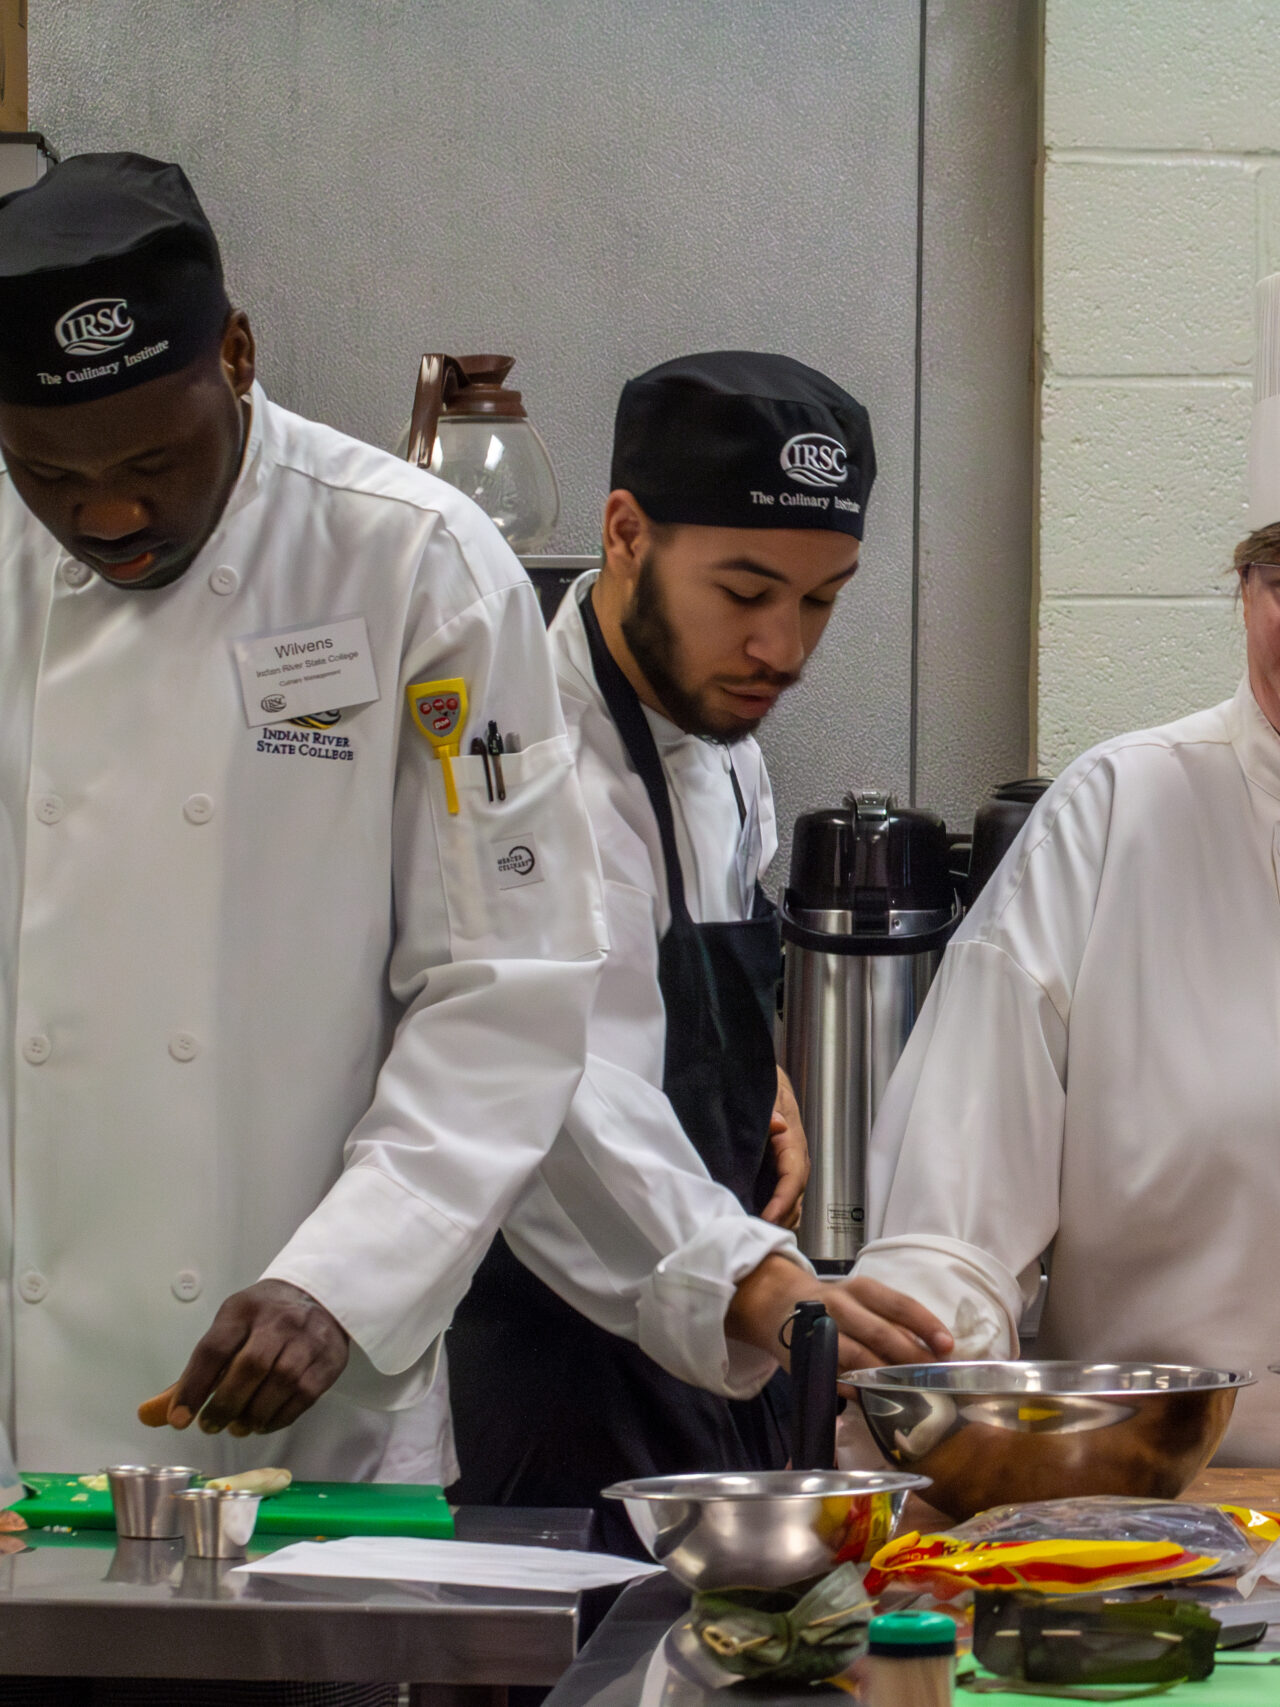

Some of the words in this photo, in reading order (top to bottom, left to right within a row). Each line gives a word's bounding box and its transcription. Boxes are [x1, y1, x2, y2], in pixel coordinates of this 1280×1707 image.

[65, 302, 133, 343] IRSC
[37, 372, 62, 385] The
[66, 361, 120, 384] Culinary
[124, 340, 170, 367] Institute
[791, 443, 848, 474] IRSC
[750, 490, 775, 505] The
[779, 492, 830, 510] Culinary
[274, 638, 334, 659] Wilvens
[256, 668, 281, 678] Indian
[282, 663, 303, 672] River
[305, 658, 327, 668] State
[327, 651, 359, 663] College
[263, 727, 310, 743] INDIAN
[312, 732, 350, 747] RIVER
[256, 740, 296, 755] STATE
[298, 744, 354, 761] COLLEGE
